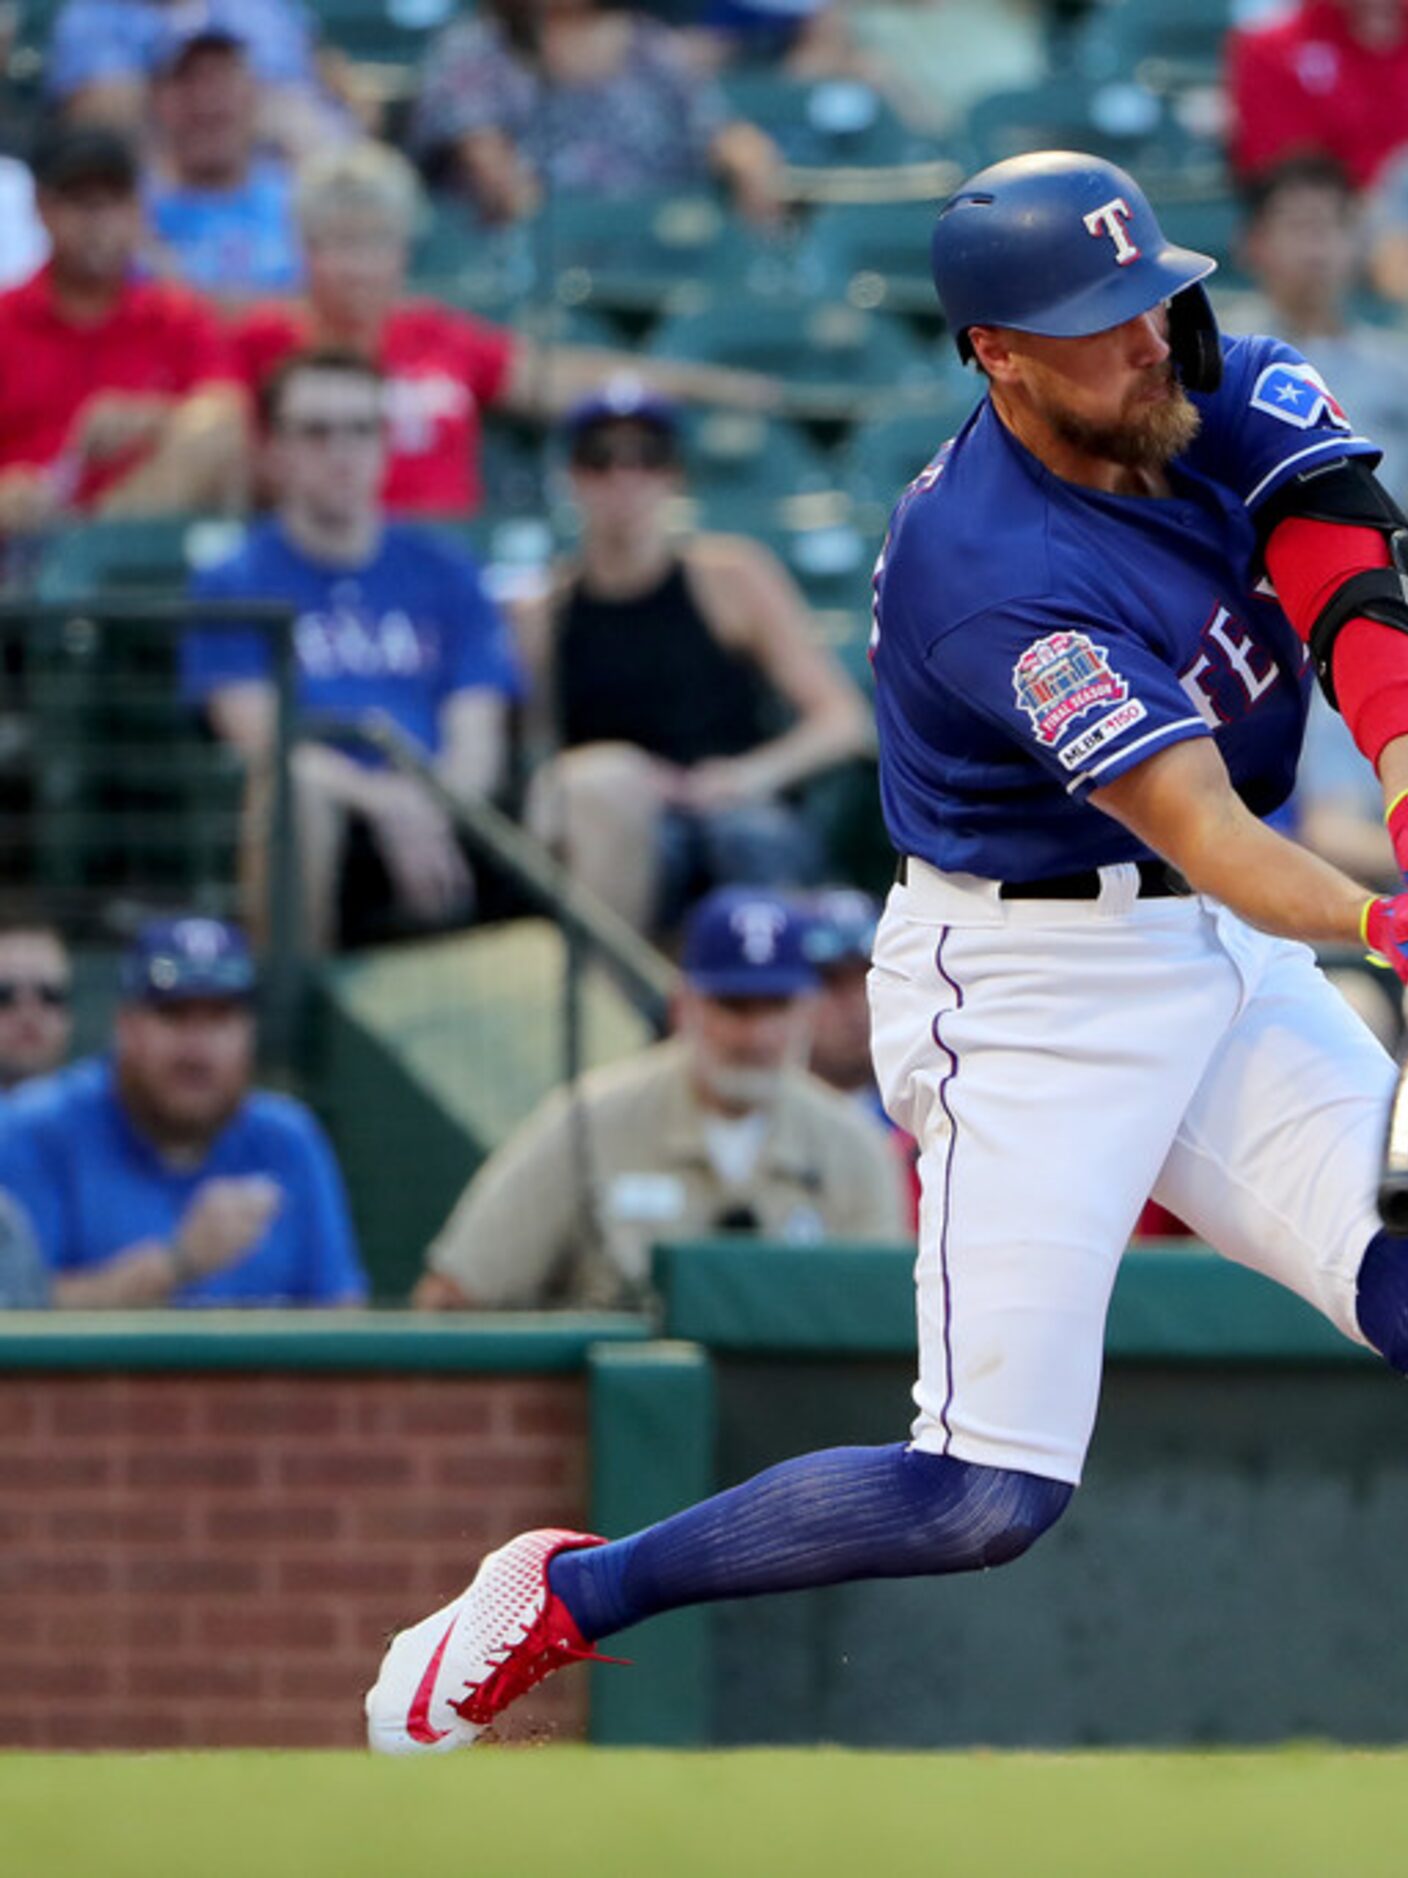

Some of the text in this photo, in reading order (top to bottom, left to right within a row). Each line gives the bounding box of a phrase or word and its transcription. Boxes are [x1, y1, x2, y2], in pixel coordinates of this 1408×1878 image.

[1082, 197, 1141, 267] T
[1042, 684, 1112, 731] FINAL SEASON
[1062, 733, 1096, 765] MLB
